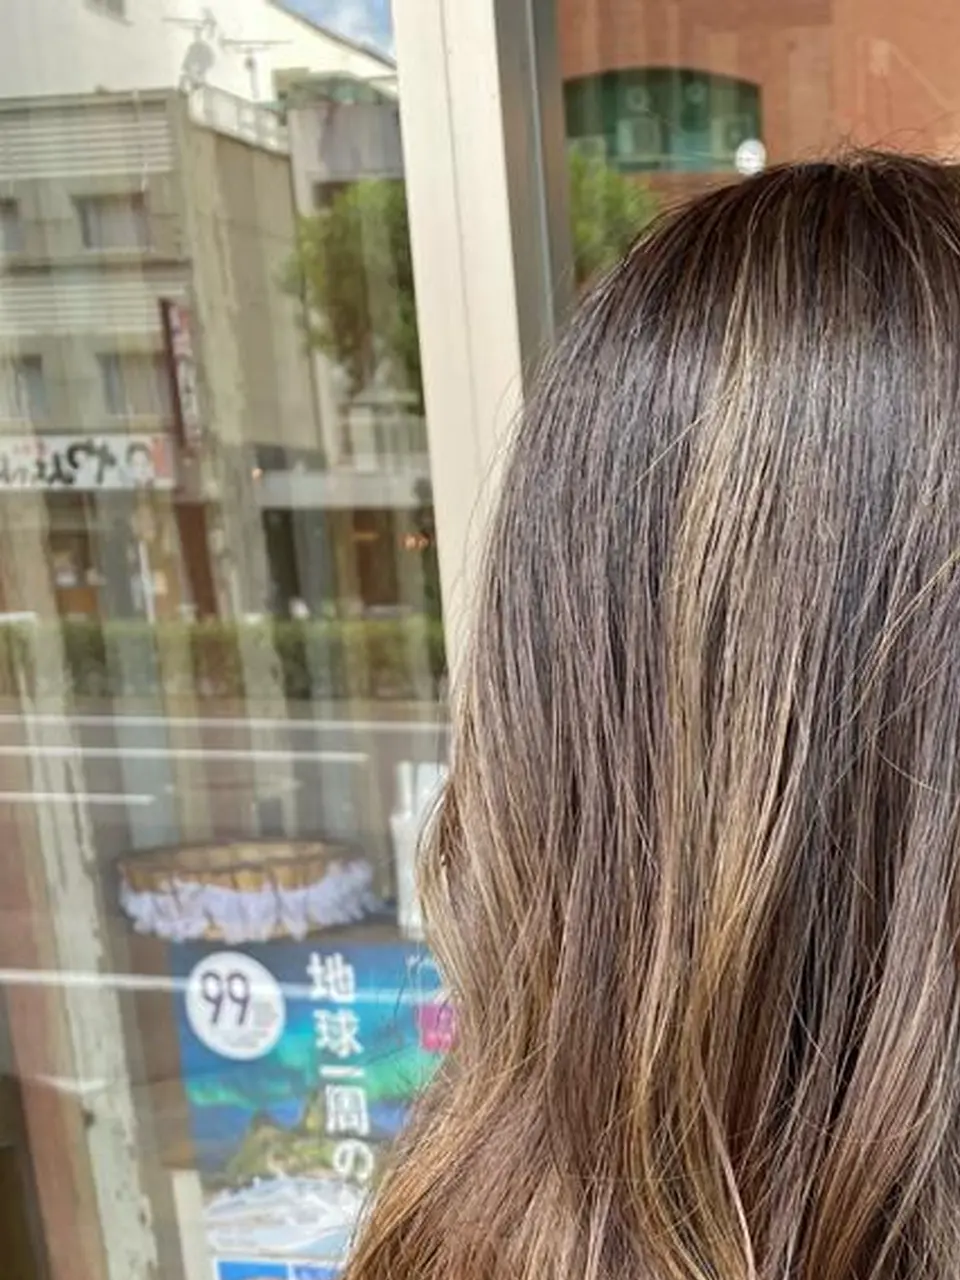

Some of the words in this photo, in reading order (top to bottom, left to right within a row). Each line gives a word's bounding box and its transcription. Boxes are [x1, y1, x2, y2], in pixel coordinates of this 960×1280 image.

[201, 970, 250, 1025] 99
[306, 951, 375, 1181] 地球一周の
